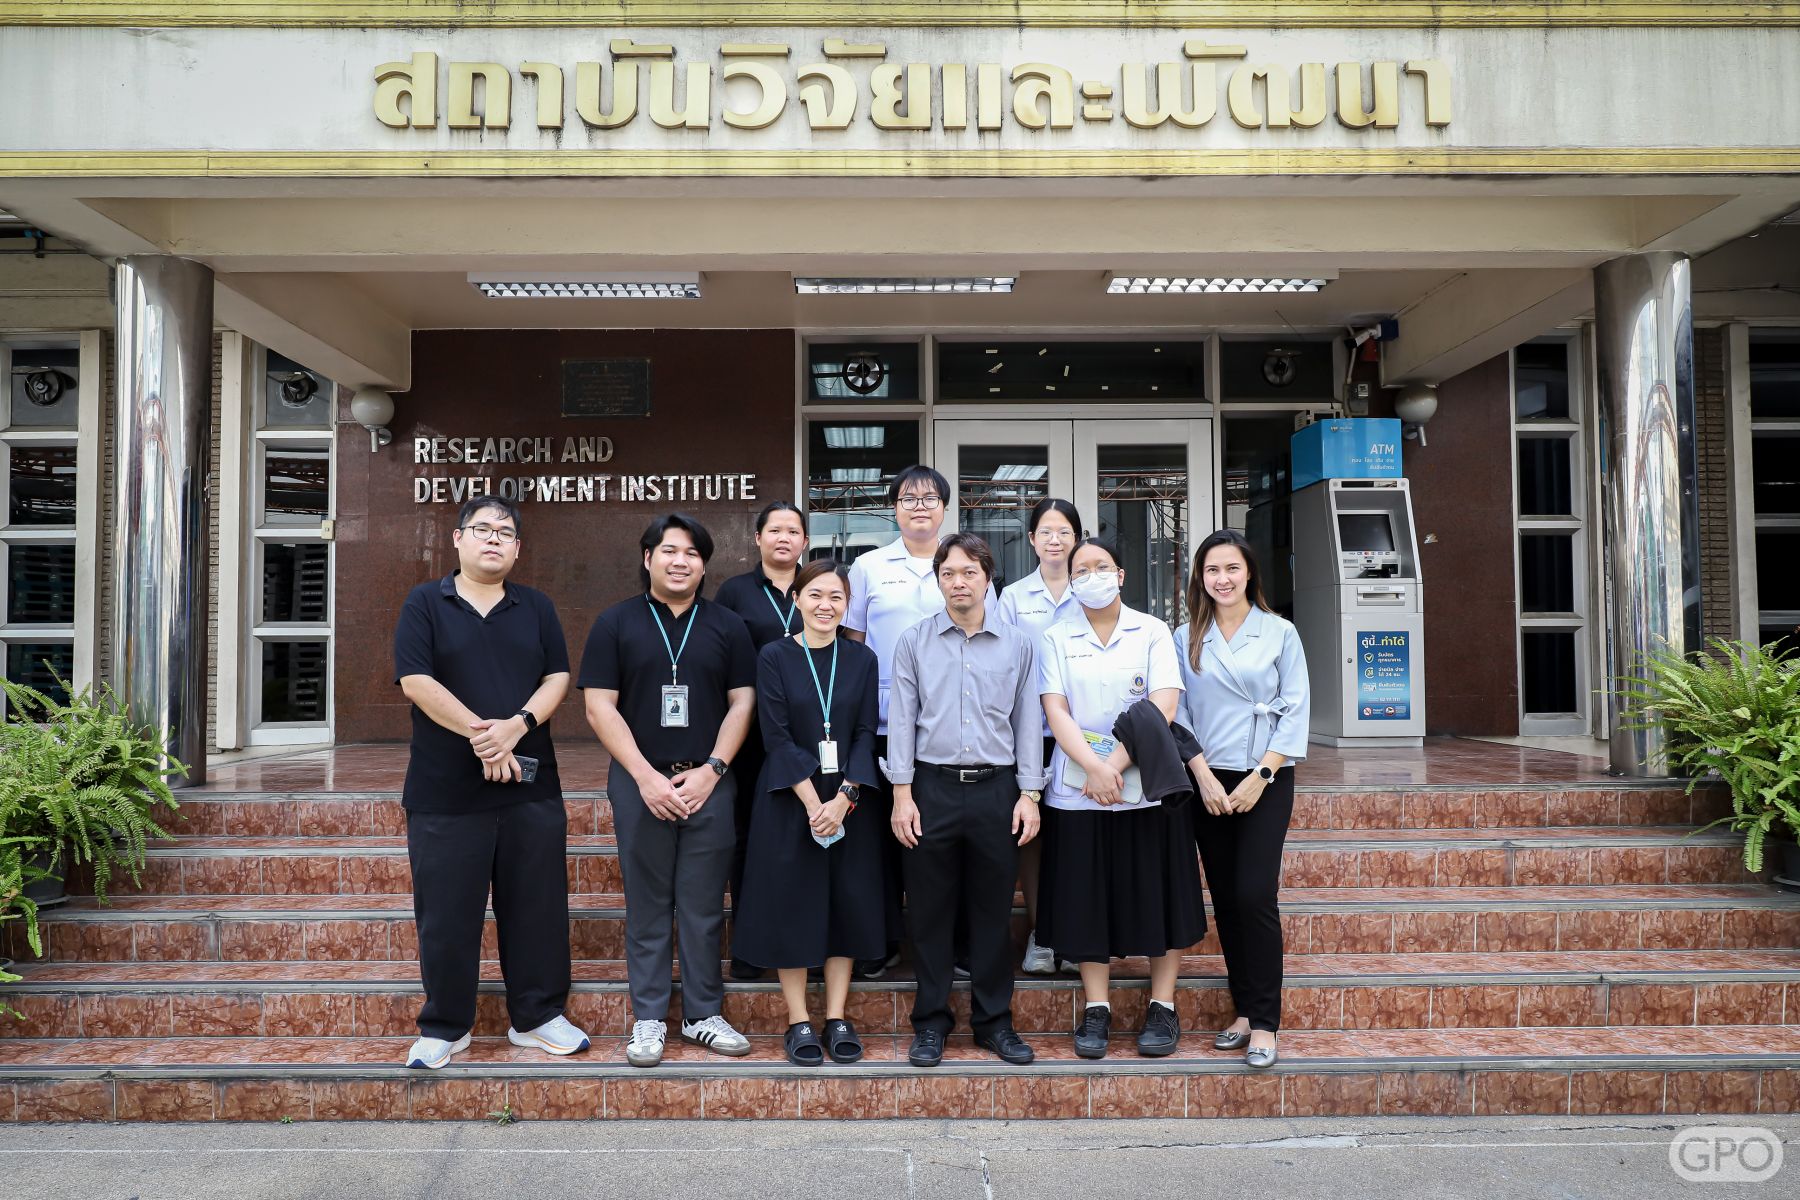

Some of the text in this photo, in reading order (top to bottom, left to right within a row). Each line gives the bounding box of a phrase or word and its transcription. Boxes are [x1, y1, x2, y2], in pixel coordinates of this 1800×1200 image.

[373, 38, 1452, 131] สถาบันวิจัยและพัฒนา
[414, 436, 614, 464] RESEARCH AND
[1370, 443, 1395, 455] ATM
[414, 474, 757, 503] DEVELOPMENT INSTITUTE
